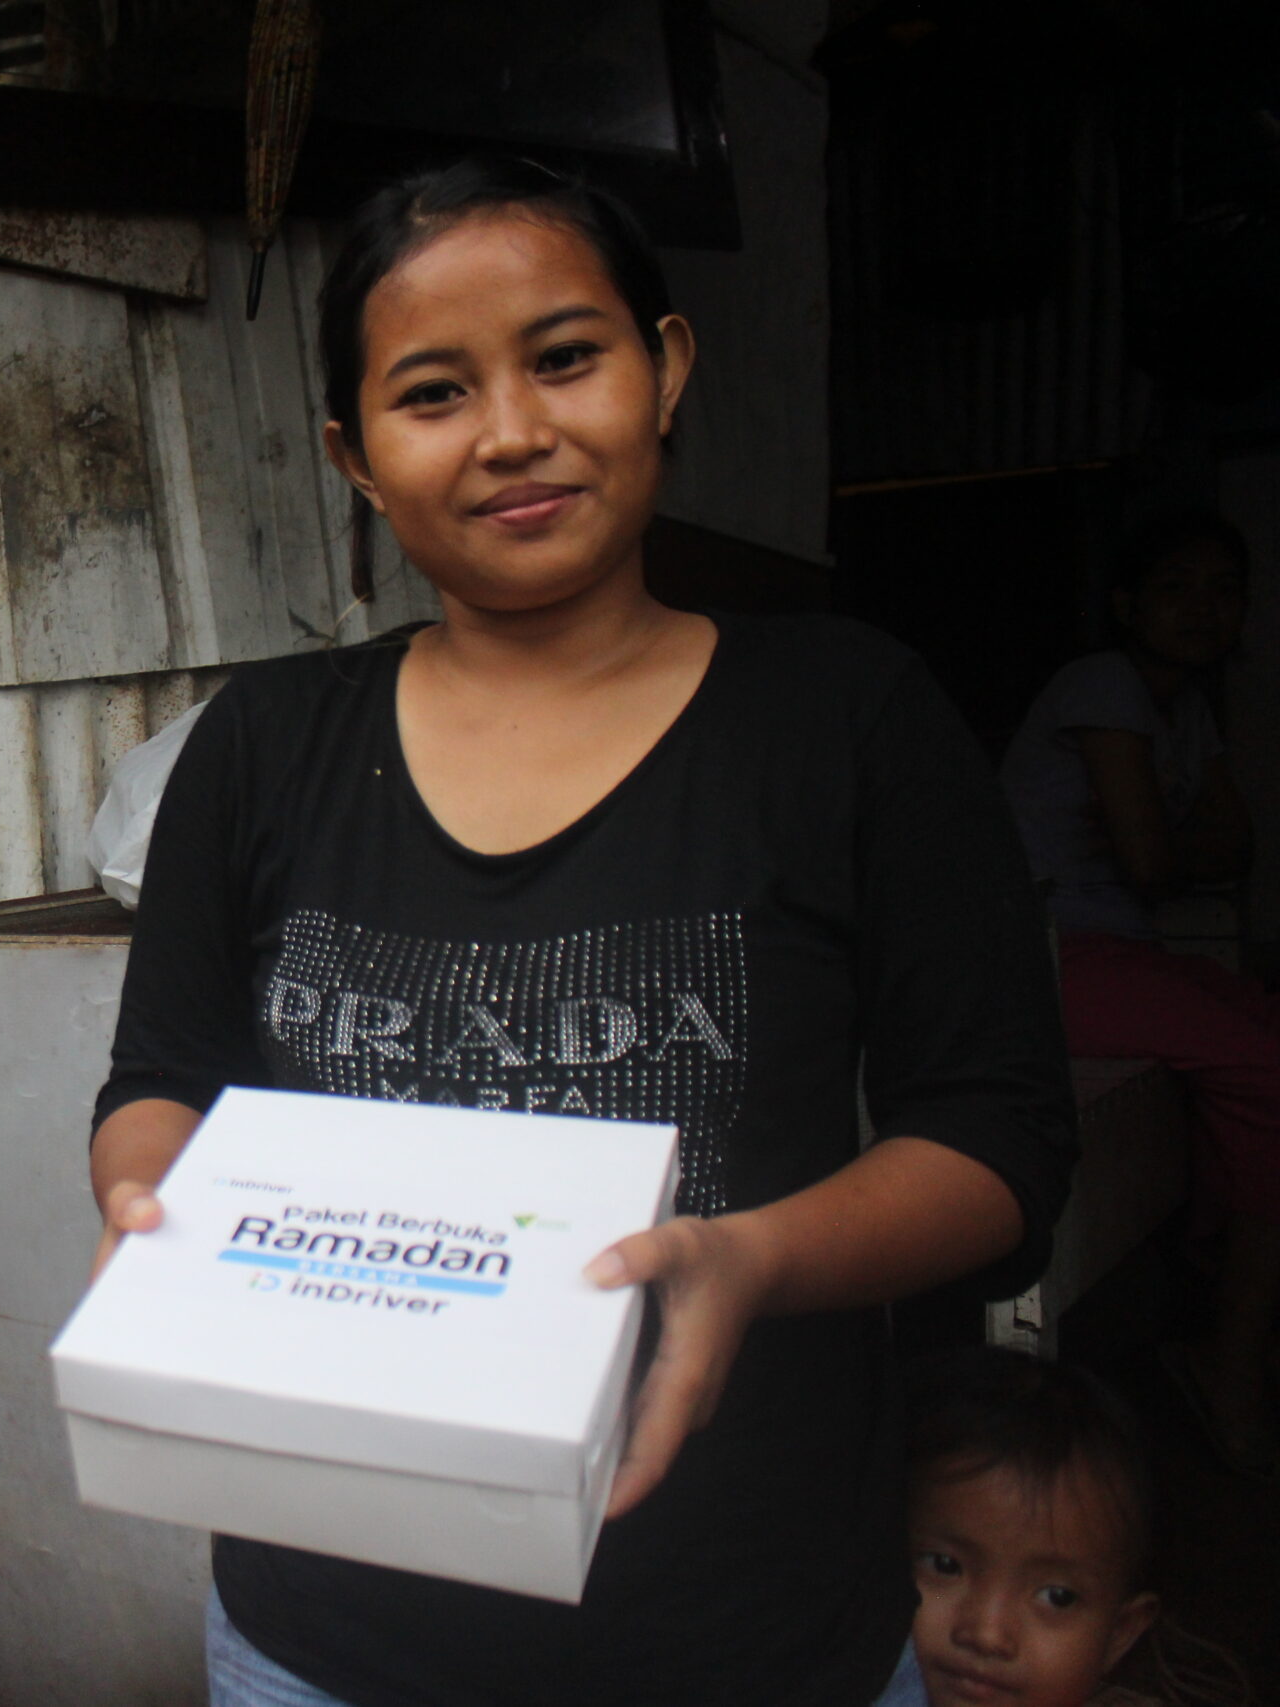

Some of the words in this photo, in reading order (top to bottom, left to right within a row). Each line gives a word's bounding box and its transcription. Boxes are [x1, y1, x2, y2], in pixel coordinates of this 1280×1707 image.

[267, 975, 734, 1067] PRADA
[229, 1215, 513, 1278] Ramadan
[376, 1211, 509, 1246] Berbuka
[290, 1276, 451, 1316] inDriver
